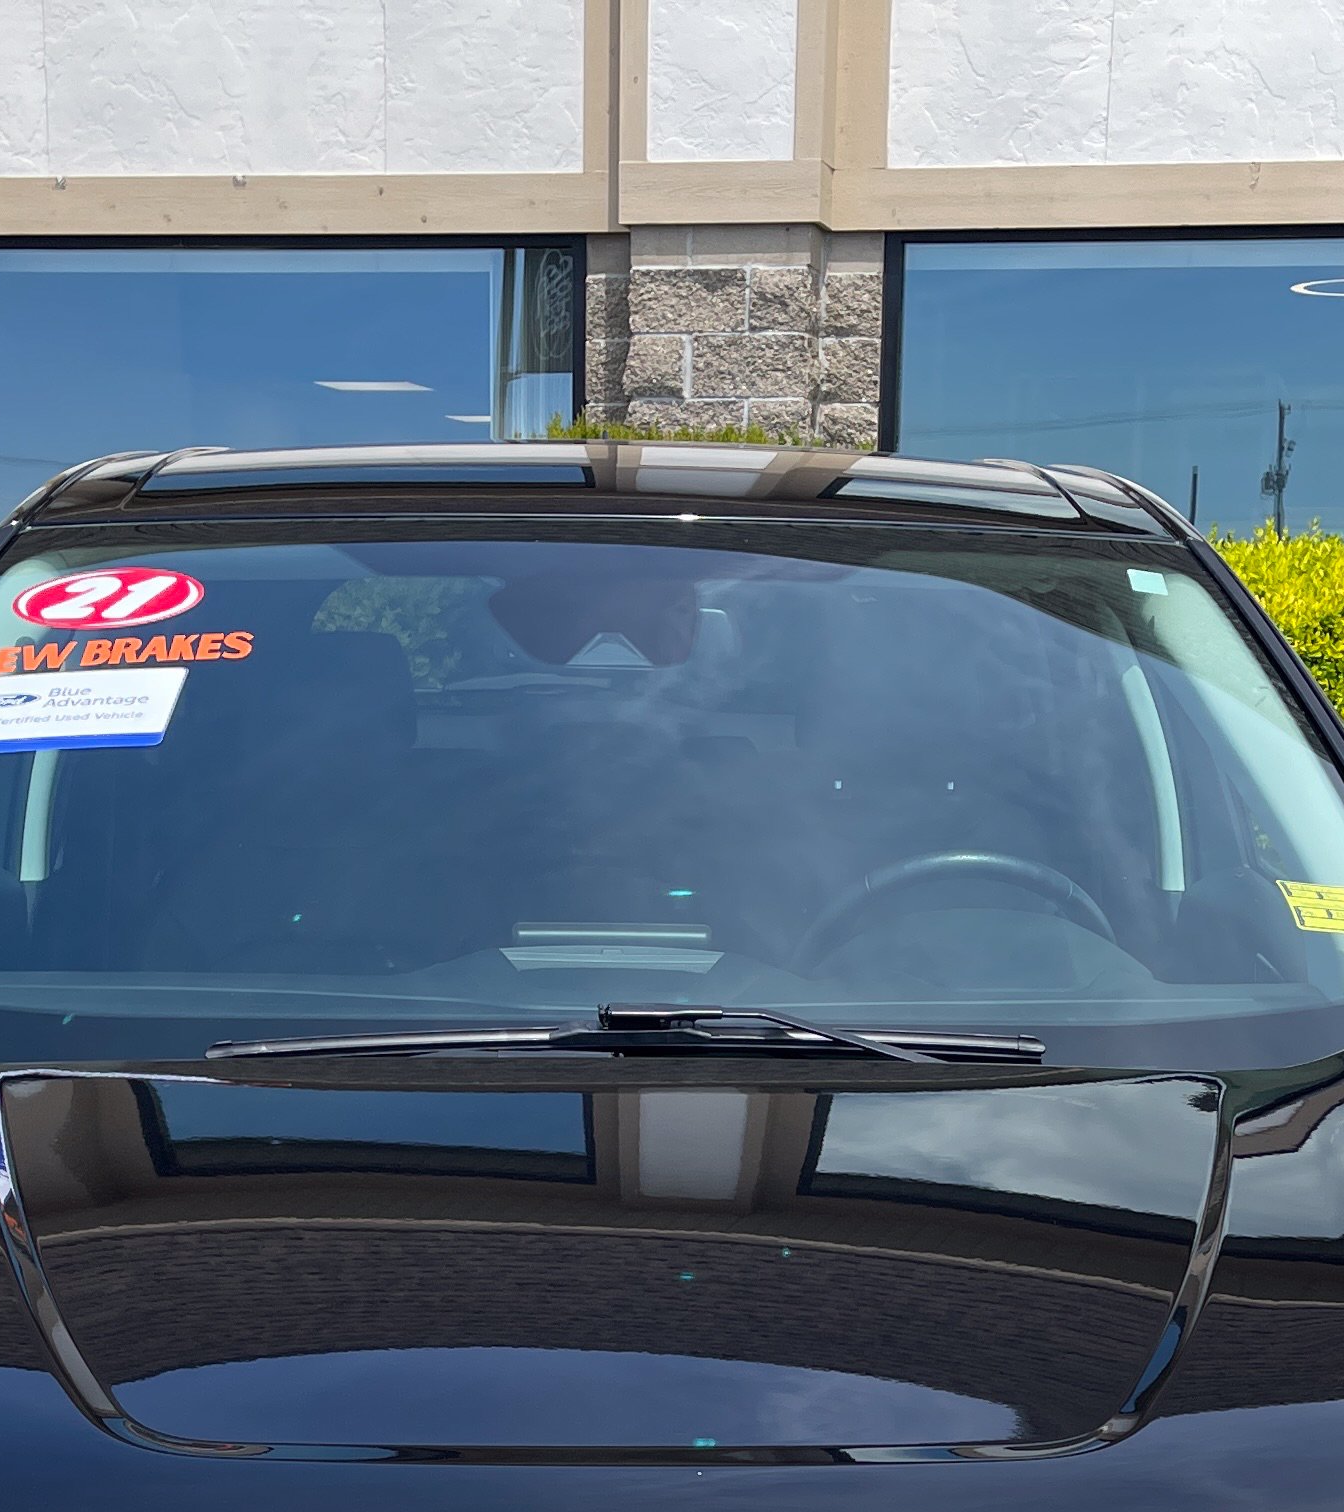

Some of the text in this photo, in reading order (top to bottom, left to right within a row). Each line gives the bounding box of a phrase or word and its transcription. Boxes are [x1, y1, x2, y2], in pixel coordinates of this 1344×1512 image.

[40, 575, 179, 620] 21
[80, 631, 256, 667] BRAKES
[48, 687, 92, 698] Blue
[42, 694, 150, 708] Advantage
[55, 713, 90, 722] Used
[95, 711, 144, 720] Vehicle
